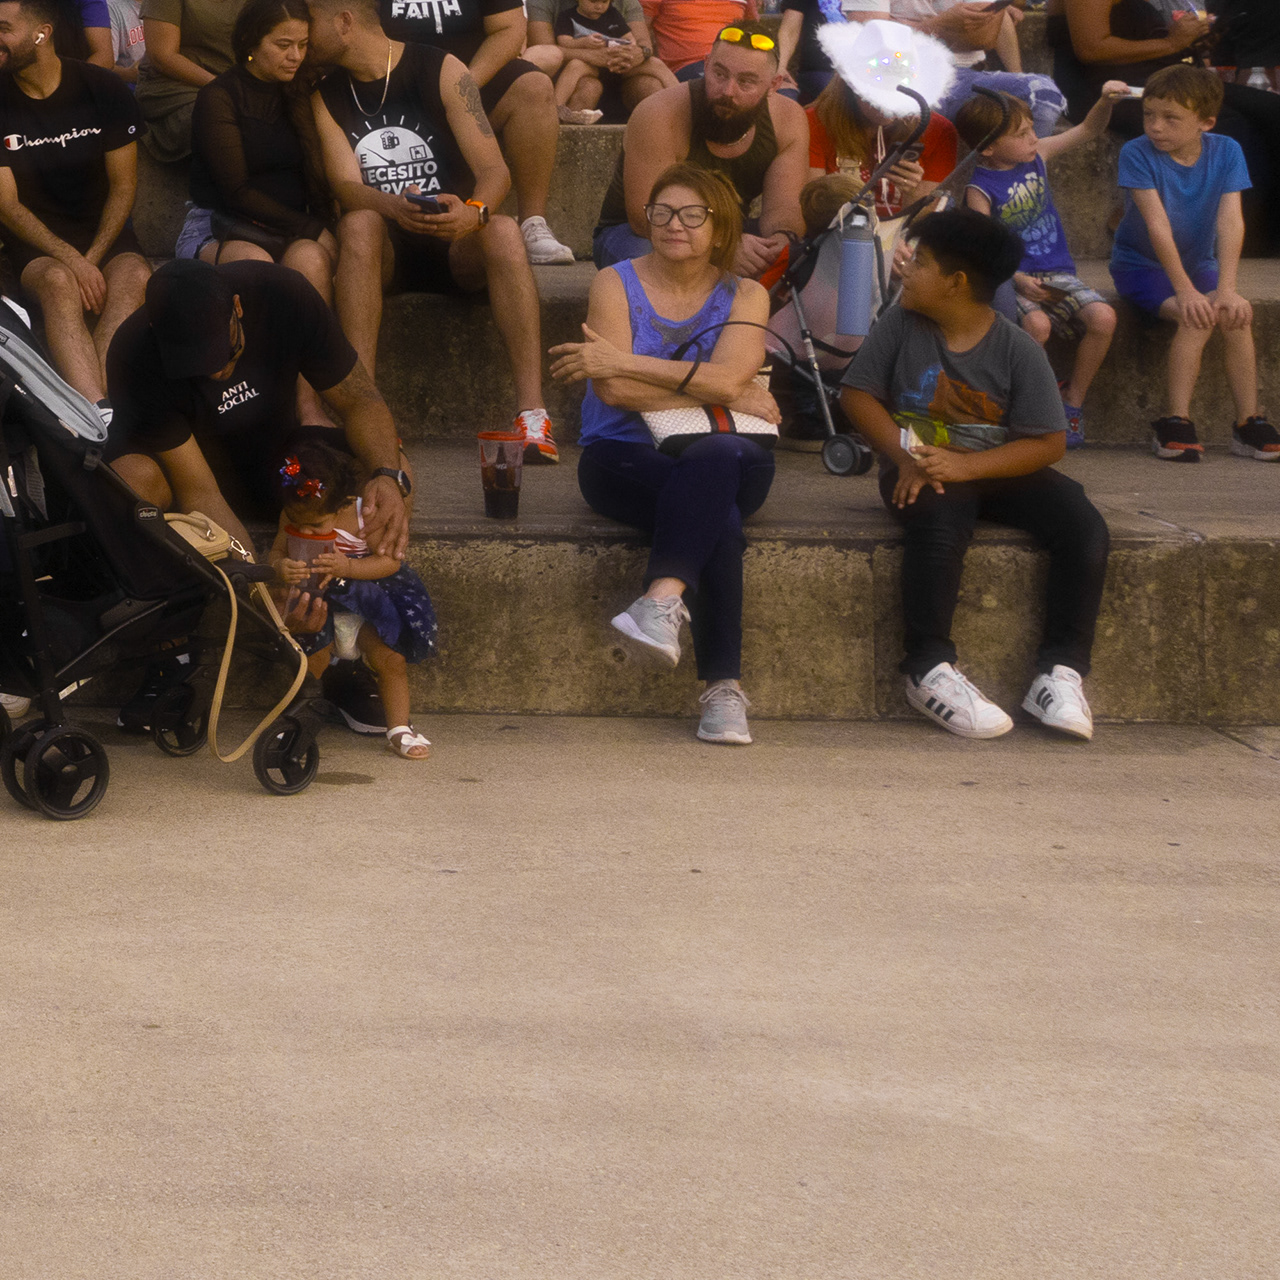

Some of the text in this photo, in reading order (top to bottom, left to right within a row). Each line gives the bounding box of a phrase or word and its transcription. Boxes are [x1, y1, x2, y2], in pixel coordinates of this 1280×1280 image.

[4, 125, 101, 151] Champion
[217, 388, 260, 414] SOCIAL
[222, 381, 248, 401] ANTI
